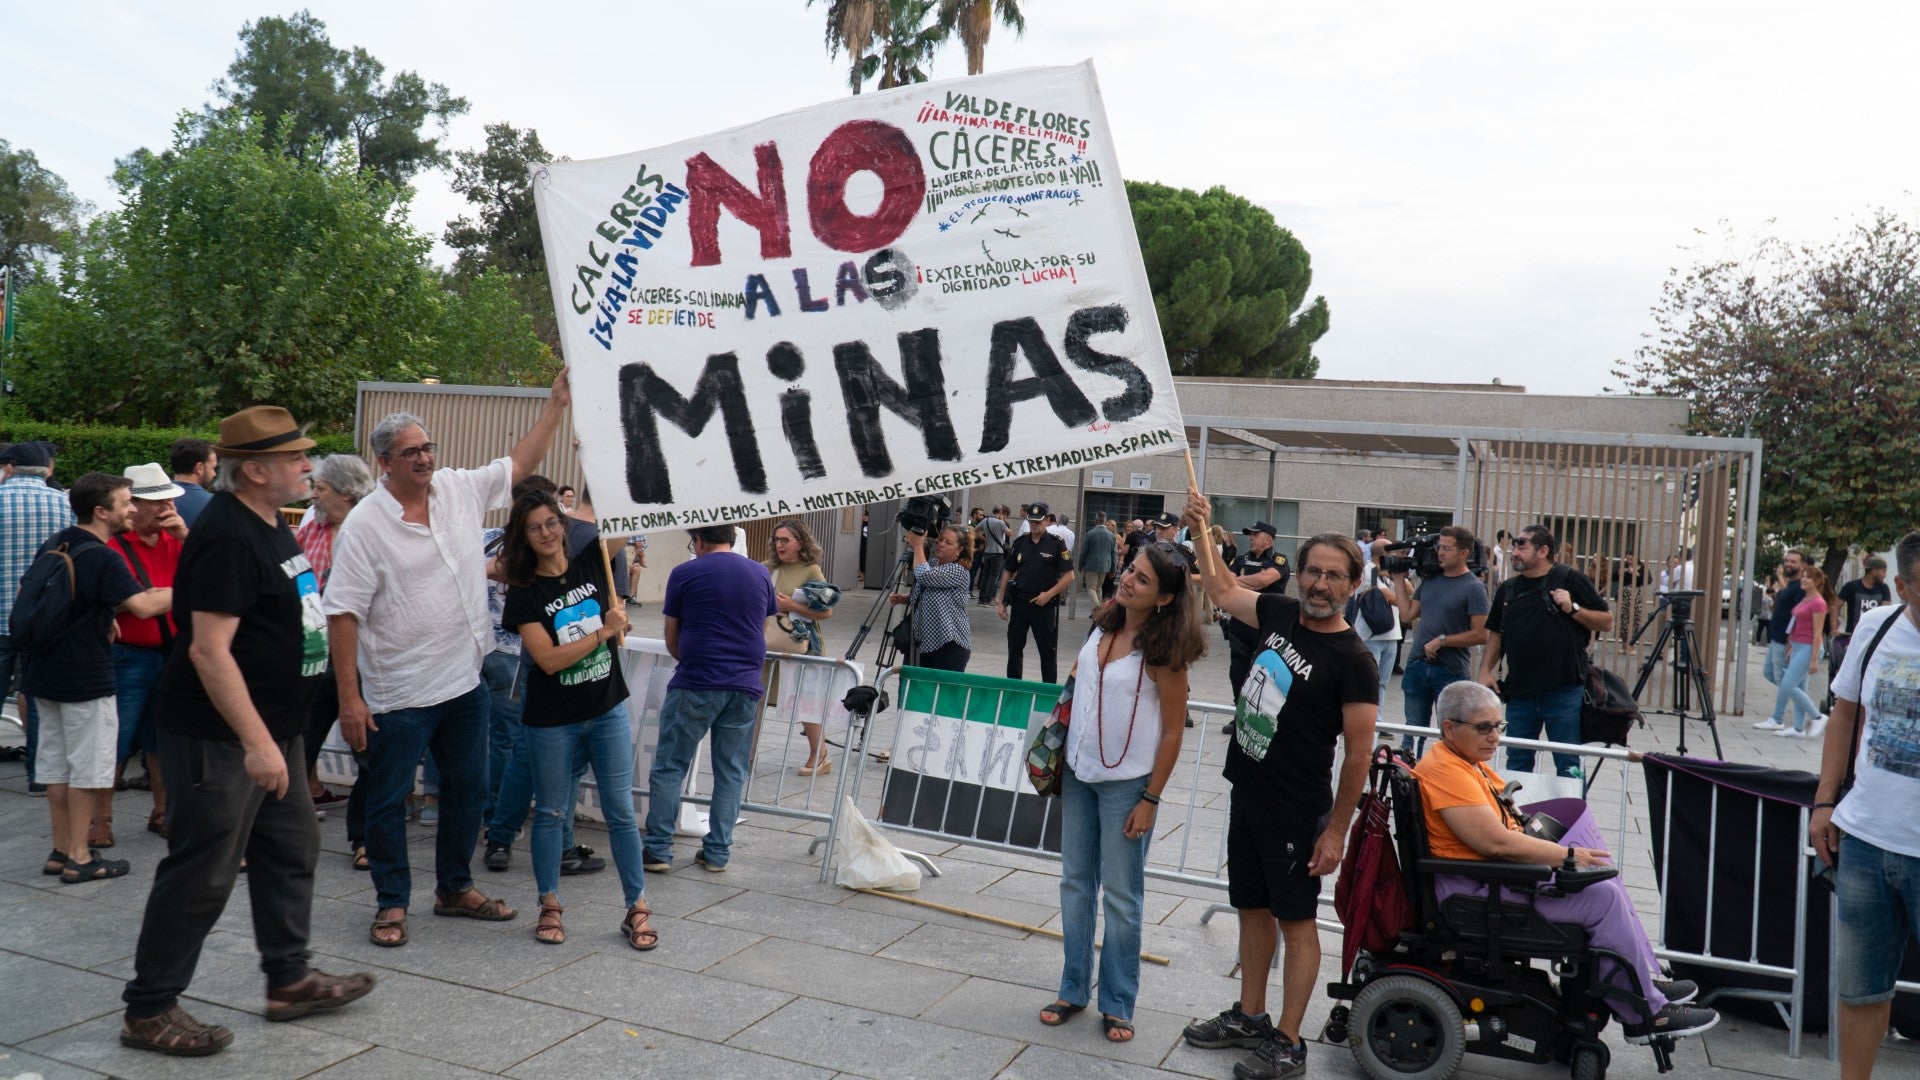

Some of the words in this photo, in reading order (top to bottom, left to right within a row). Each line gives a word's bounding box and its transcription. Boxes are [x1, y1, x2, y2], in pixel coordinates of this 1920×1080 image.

[944, 90, 1091, 139] VALDEFLORES
[1023, 156, 1067, 171] MOSCA
[685, 118, 927, 267] NO
[1076, 251, 1097, 266] SU
[744, 274, 782, 321] A
[792, 247, 907, 313] LAS
[942, 275, 1011, 295] DIGNIDAD
[628, 308, 644, 324] SE
[647, 308, 717, 329] DEFIENDE
[544, 598, 565, 617] NO
[566, 582, 598, 606] MINA
[1265, 632, 1286, 650] NO
[1282, 642, 1313, 681] MINA
